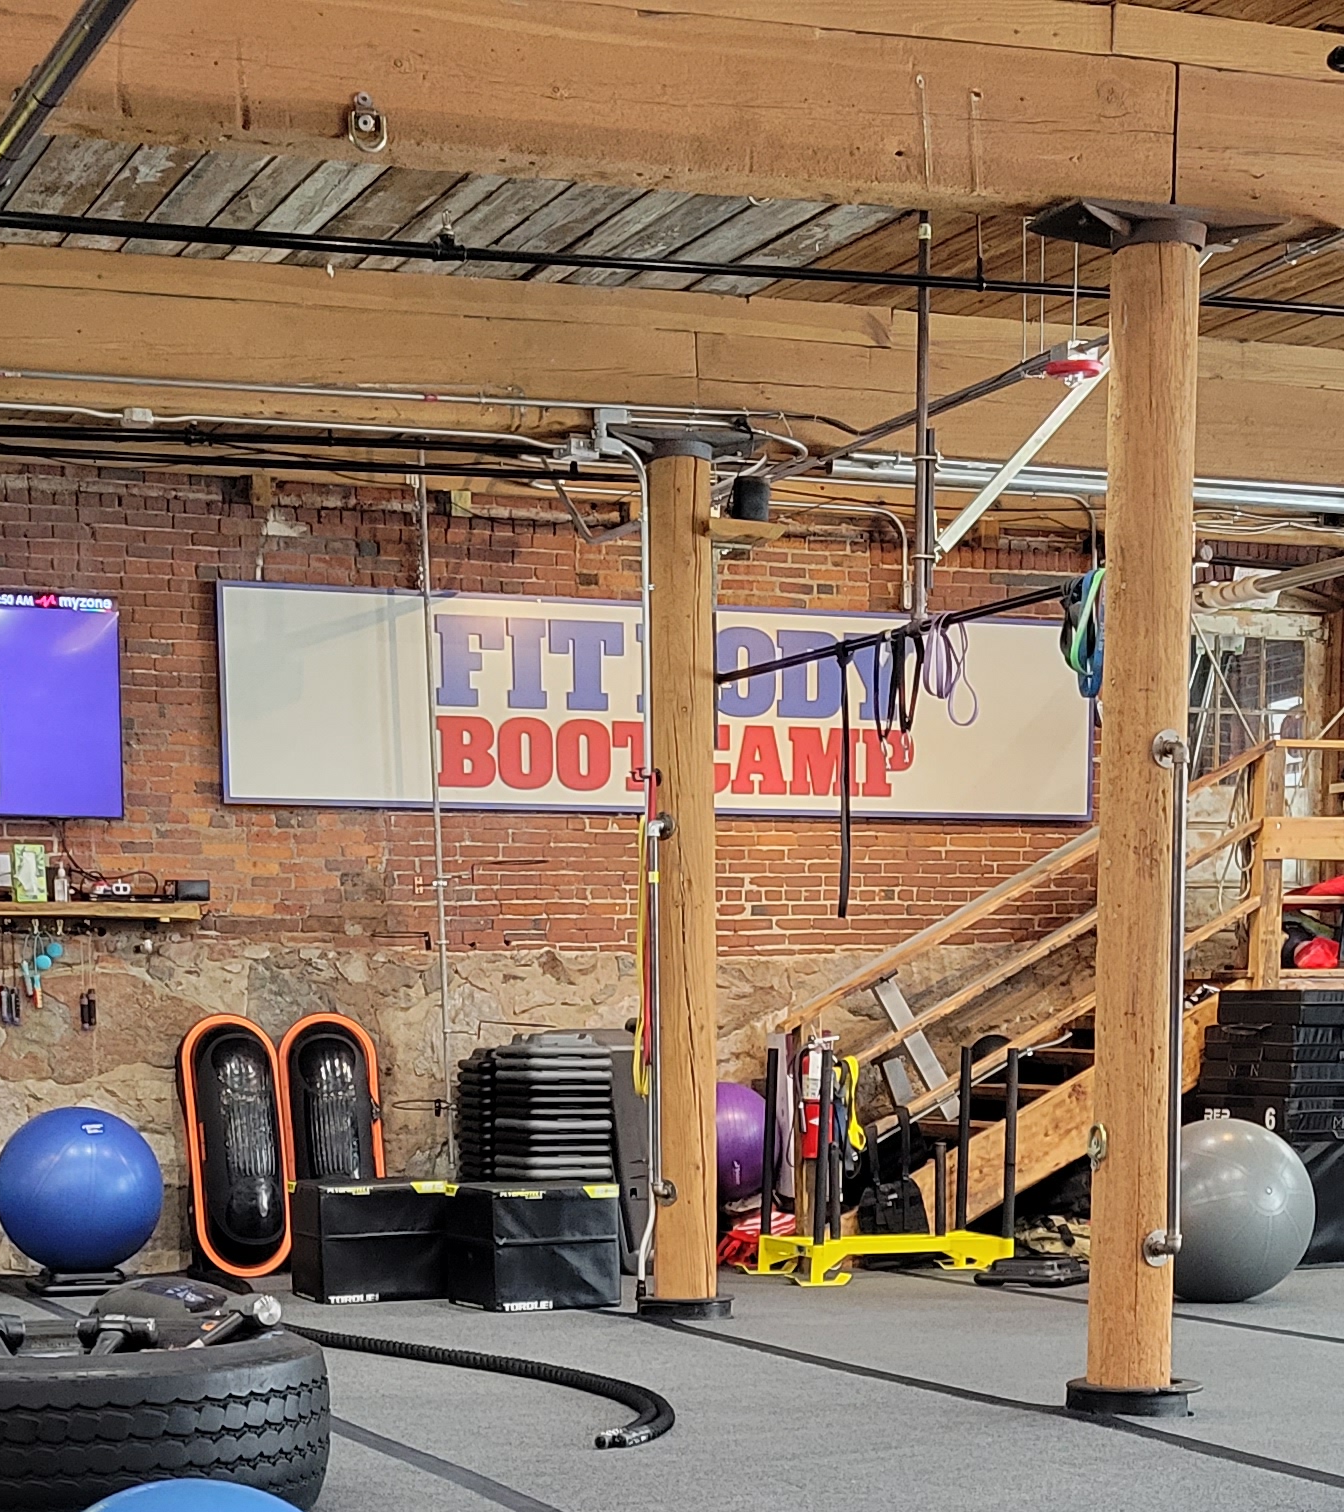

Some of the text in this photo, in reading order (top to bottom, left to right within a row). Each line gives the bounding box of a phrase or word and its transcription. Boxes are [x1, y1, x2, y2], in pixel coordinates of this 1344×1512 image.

[15, 594, 35, 607] AM
[58, 595, 113, 611] myzone
[434, 613, 914, 722] FIT ODY
[1264, 1107, 1277, 1131] 6
